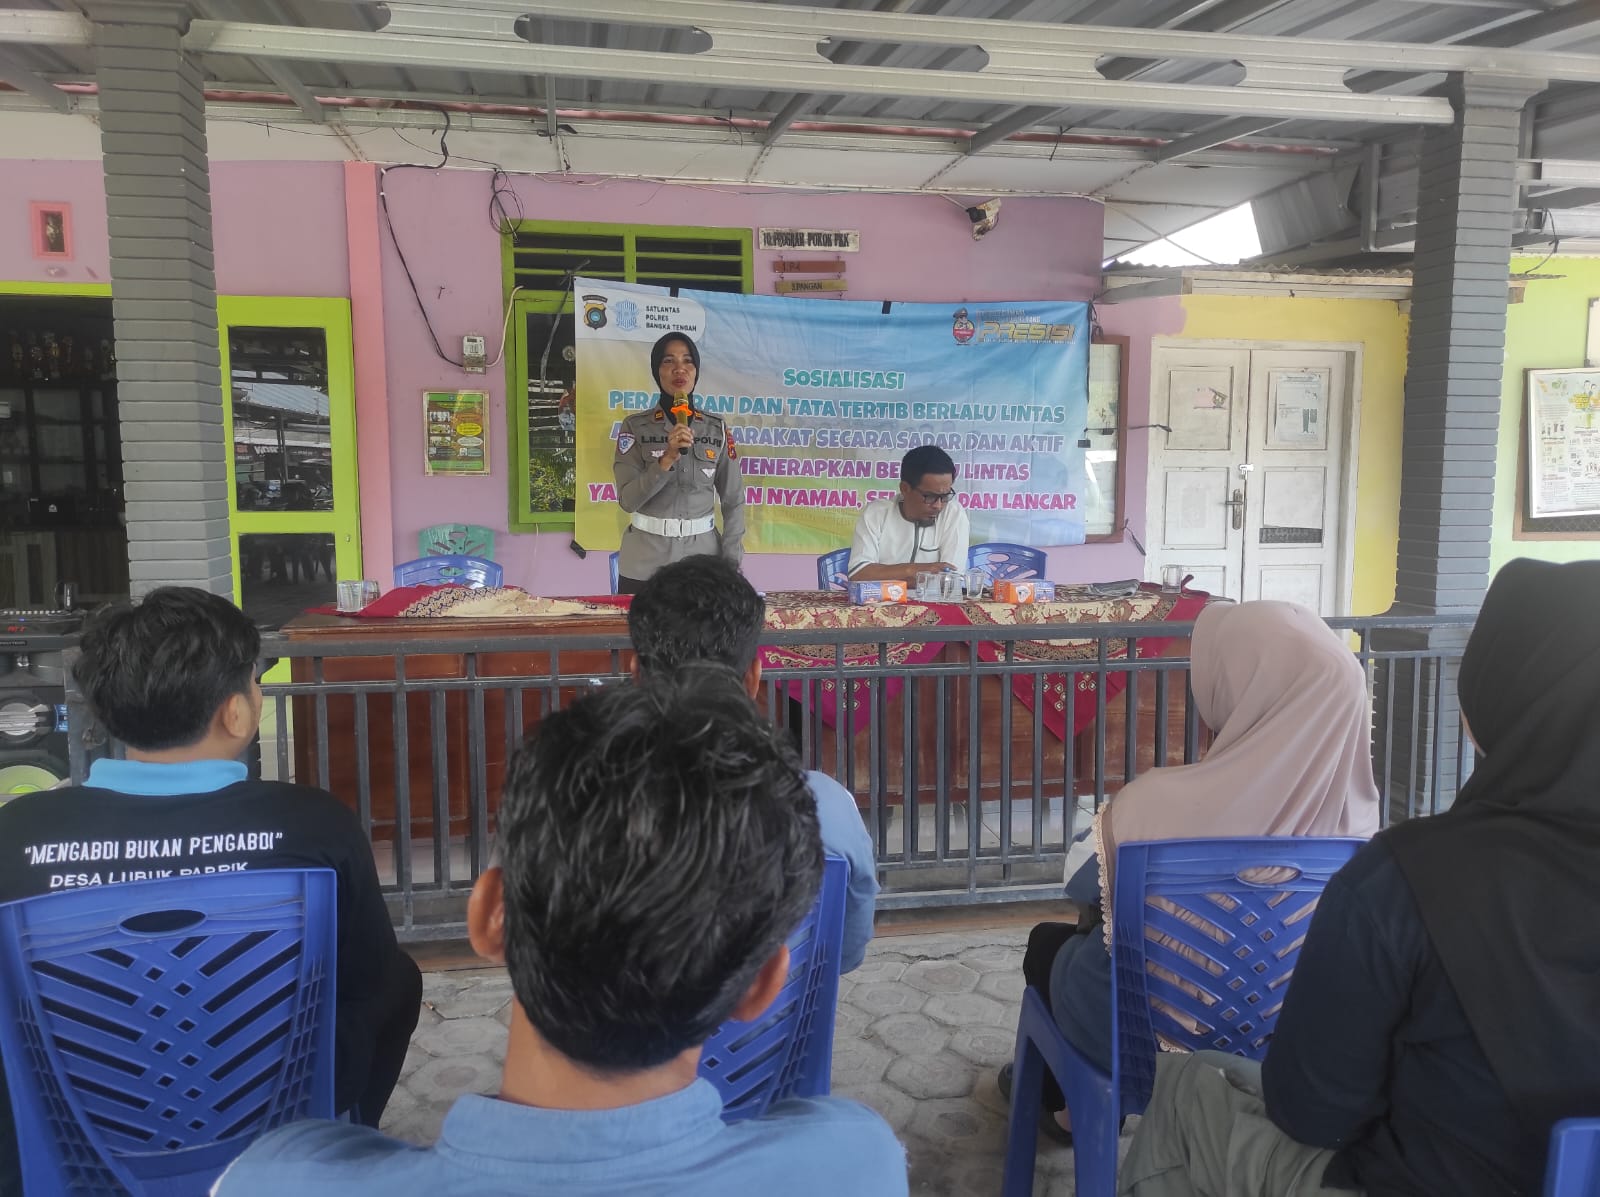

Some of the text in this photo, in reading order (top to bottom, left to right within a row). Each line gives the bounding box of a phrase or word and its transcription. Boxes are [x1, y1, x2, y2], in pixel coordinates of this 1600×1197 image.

[807, 232, 832, 247] POKOK
[645, 305, 681, 314] SATLANTAS
[645, 314, 669, 322] POLRES
[645, 322, 697, 332] BANGKA TENGAH
[981, 321, 1076, 340] PRESISI
[783, 368, 905, 390] SOSIALISASI
[608, 390, 1065, 424] PERARAN DAN TATA TERTIB BERLALU LINTAS
[816, 428, 893, 449] SECARA
[896, 430, 962, 451] SADAR
[965, 432, 1006, 452] DAN
[1009, 433, 1065, 453] AKTIF
[964, 462, 1030, 481] LINTAS
[766, 487, 863, 510] NYAMAN,
[958, 492, 1001, 511] DAN
[1002, 493, 1077, 512] LANCAR
[124, 838, 182, 860] BUKAN
[49, 873, 103, 888] DESA
